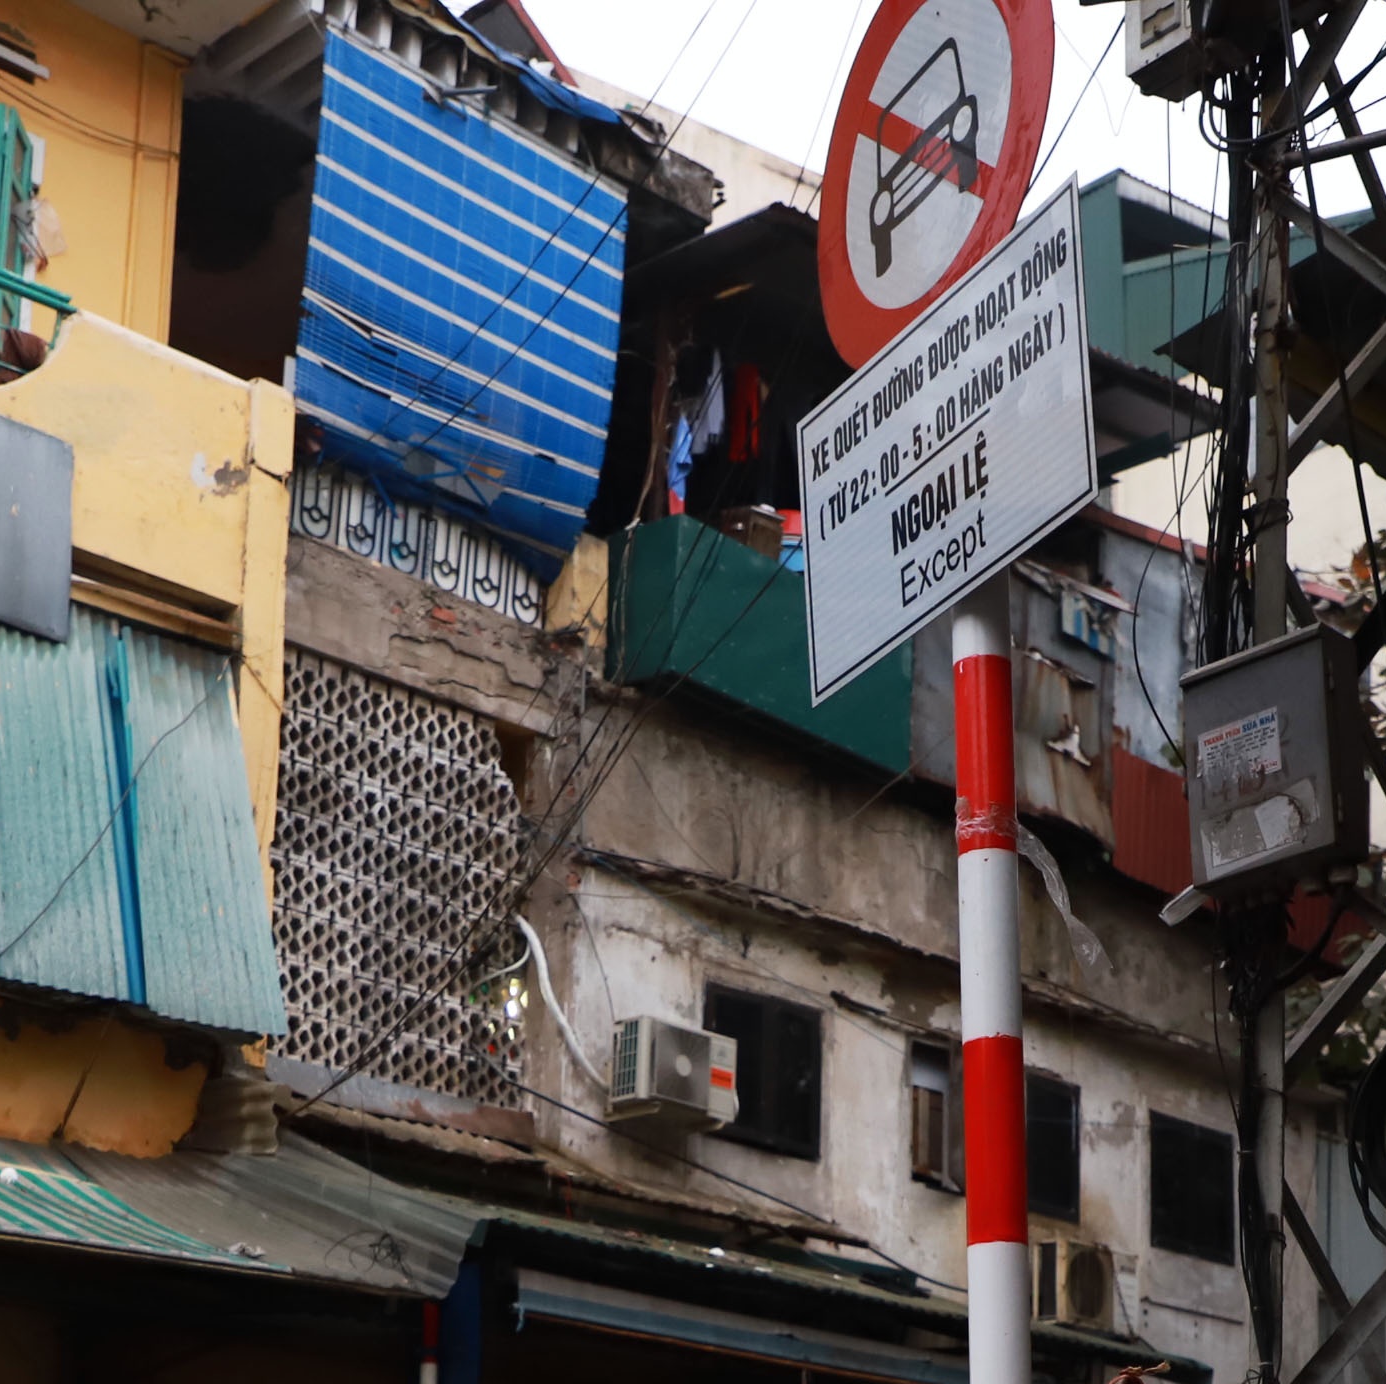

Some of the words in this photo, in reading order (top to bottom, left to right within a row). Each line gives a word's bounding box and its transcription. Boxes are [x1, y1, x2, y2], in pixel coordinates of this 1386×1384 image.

[811, 438, 831, 482] XE
[833, 402, 869, 462] QUÉT
[872, 355, 924, 429] ĐƯỜNG
[927, 314, 972, 381] ĐƯỢC
[974, 272, 1017, 341] HOẠT
[1020, 228, 1068, 301] ĐỘNG
[959, 355, 1004, 423] HÀNG
[891, 464, 957, 556] NGOẠI
[962, 430, 989, 499] LỆ
[901, 508, 986, 608] Except
